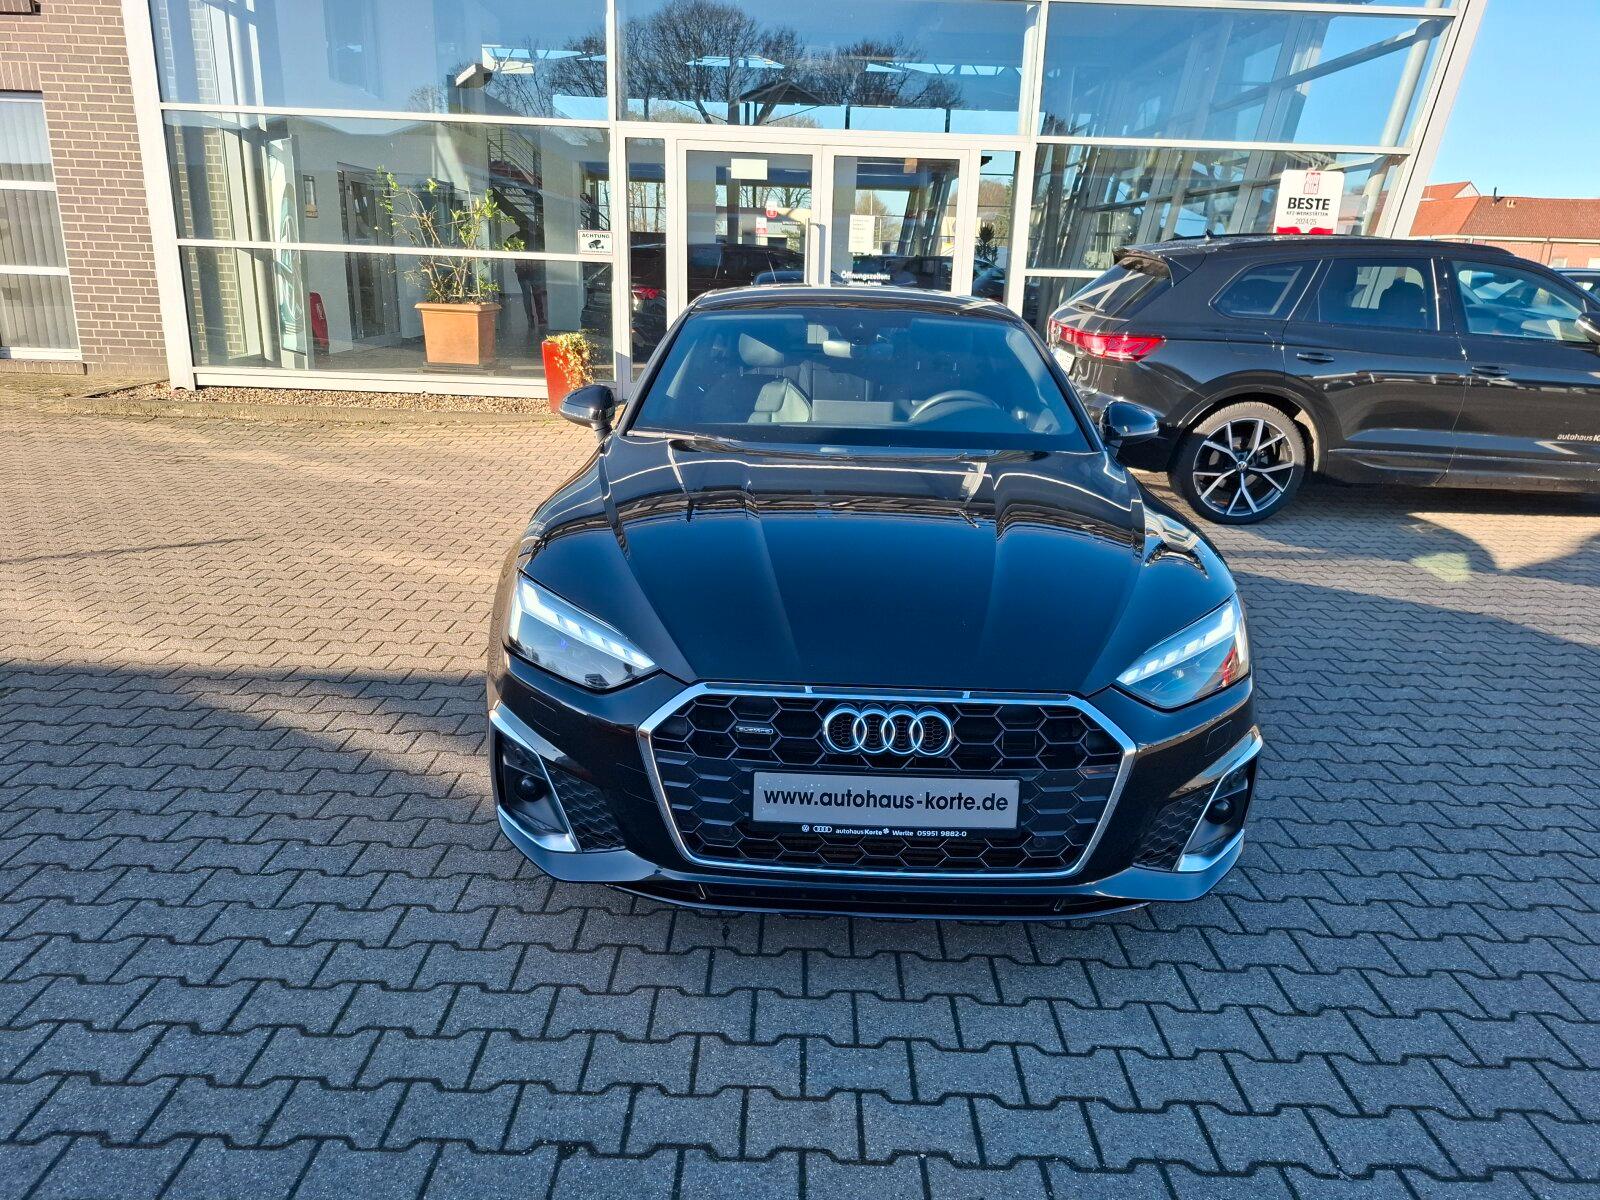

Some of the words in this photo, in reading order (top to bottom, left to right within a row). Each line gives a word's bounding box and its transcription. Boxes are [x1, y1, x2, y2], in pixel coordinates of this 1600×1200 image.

[1287, 197, 1330, 210] BESTE
[1557, 433, 1593, 442] autohaus
[763, 788, 1009, 812] www.autohaus-korte.de
